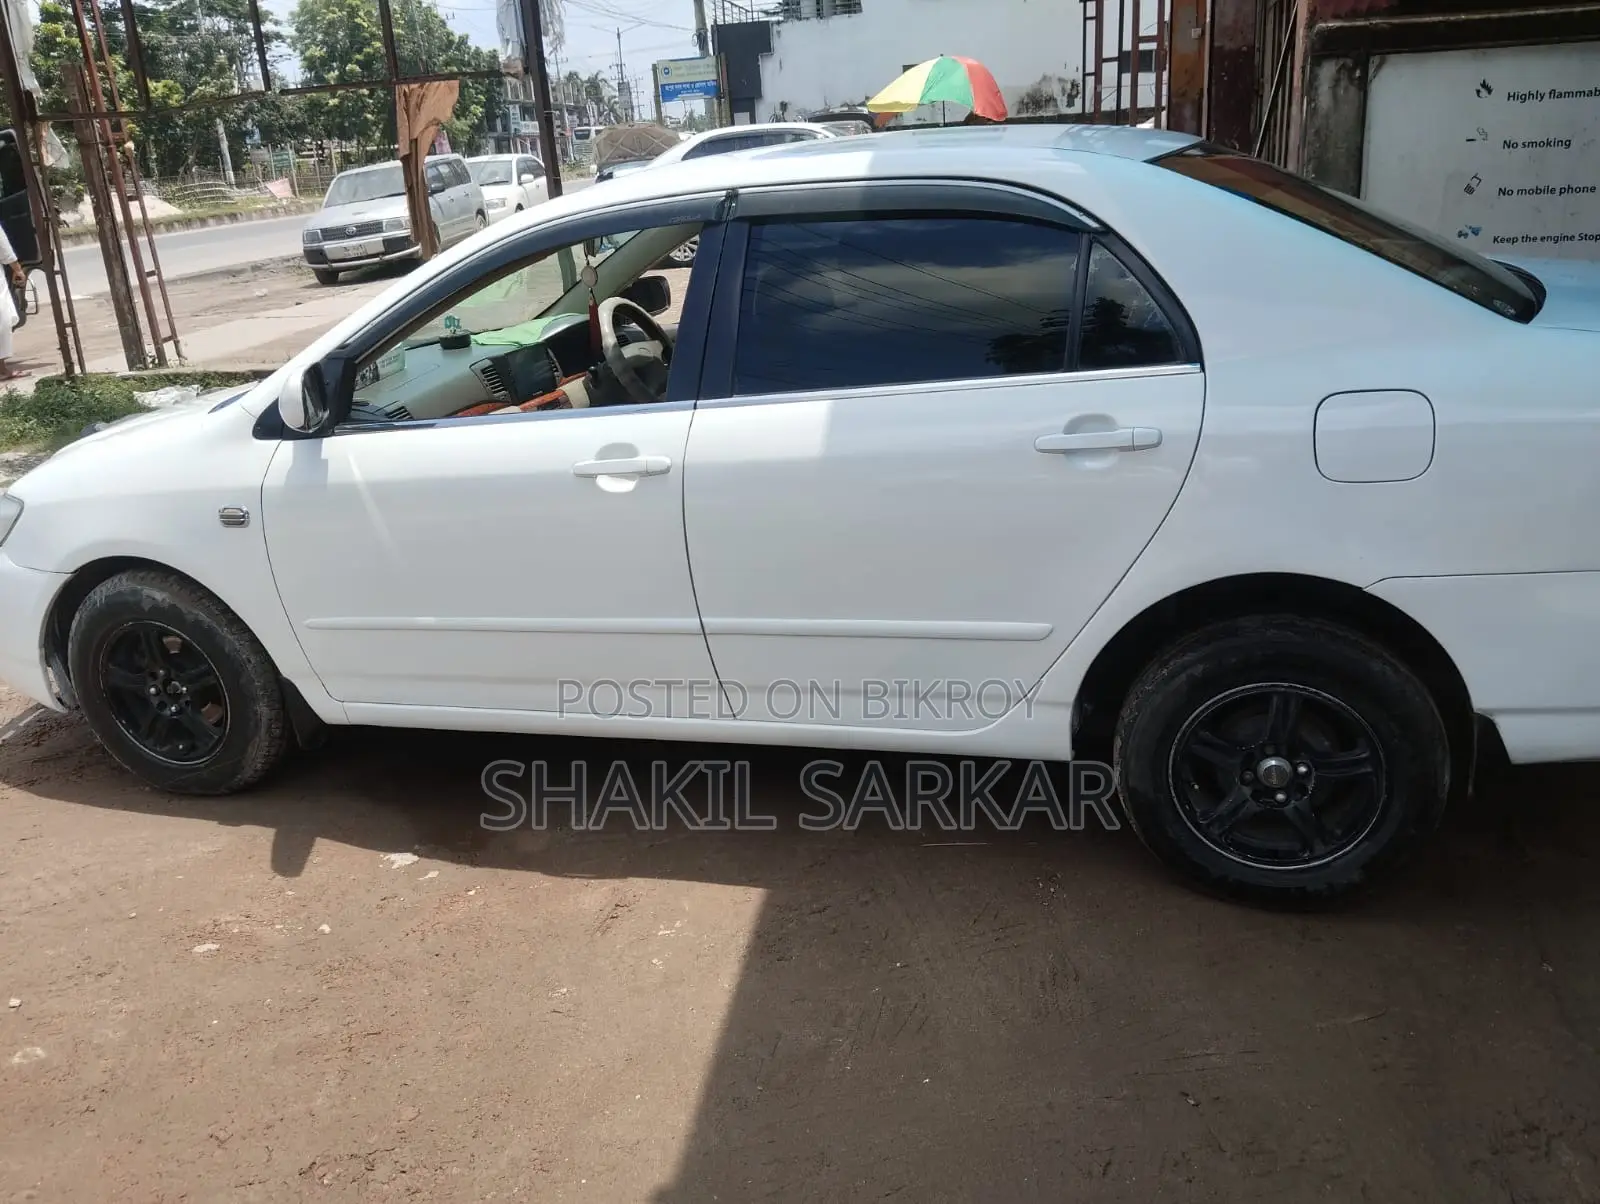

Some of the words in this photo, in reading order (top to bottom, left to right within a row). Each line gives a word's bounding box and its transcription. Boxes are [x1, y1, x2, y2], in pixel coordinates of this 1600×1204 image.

[1507, 89, 1546, 103] Highly
[1502, 139, 1518, 149] No
[1521, 137, 1572, 149] smoking
[1498, 187, 1514, 196] No
[1516, 185, 1556, 196] mobile
[1558, 184, 1597, 196] phone
[1493, 235, 1518, 245] Keep
[1521, 234, 1538, 243] the
[1540, 233, 1576, 244] engine
[1577, 232, 1600, 243] Stop
